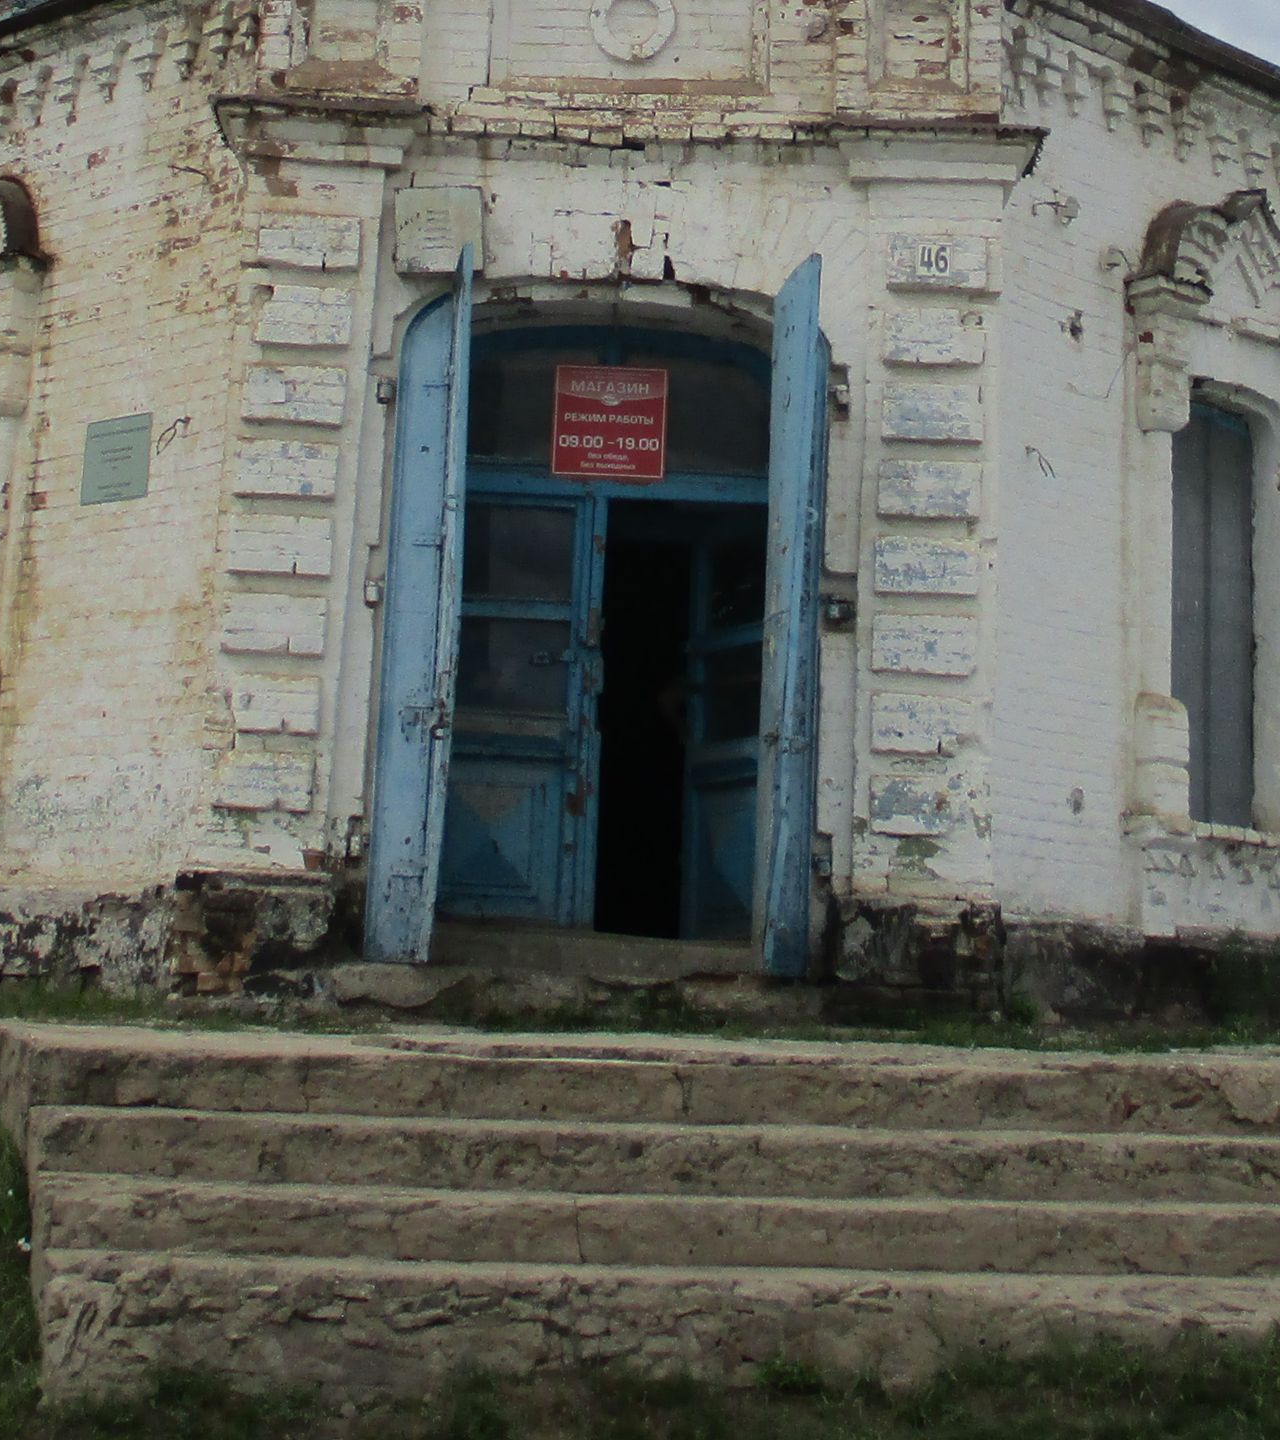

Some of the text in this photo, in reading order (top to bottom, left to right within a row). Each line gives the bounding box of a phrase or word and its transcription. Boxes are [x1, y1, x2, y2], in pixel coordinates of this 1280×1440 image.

[920, 245, 949, 273] 46
[571, 380, 649, 394] МАГАЗИН
[564, 412, 654, 425] РЕЖИМ РАБОТЫ
[558, 434, 604, 448] 09.00
